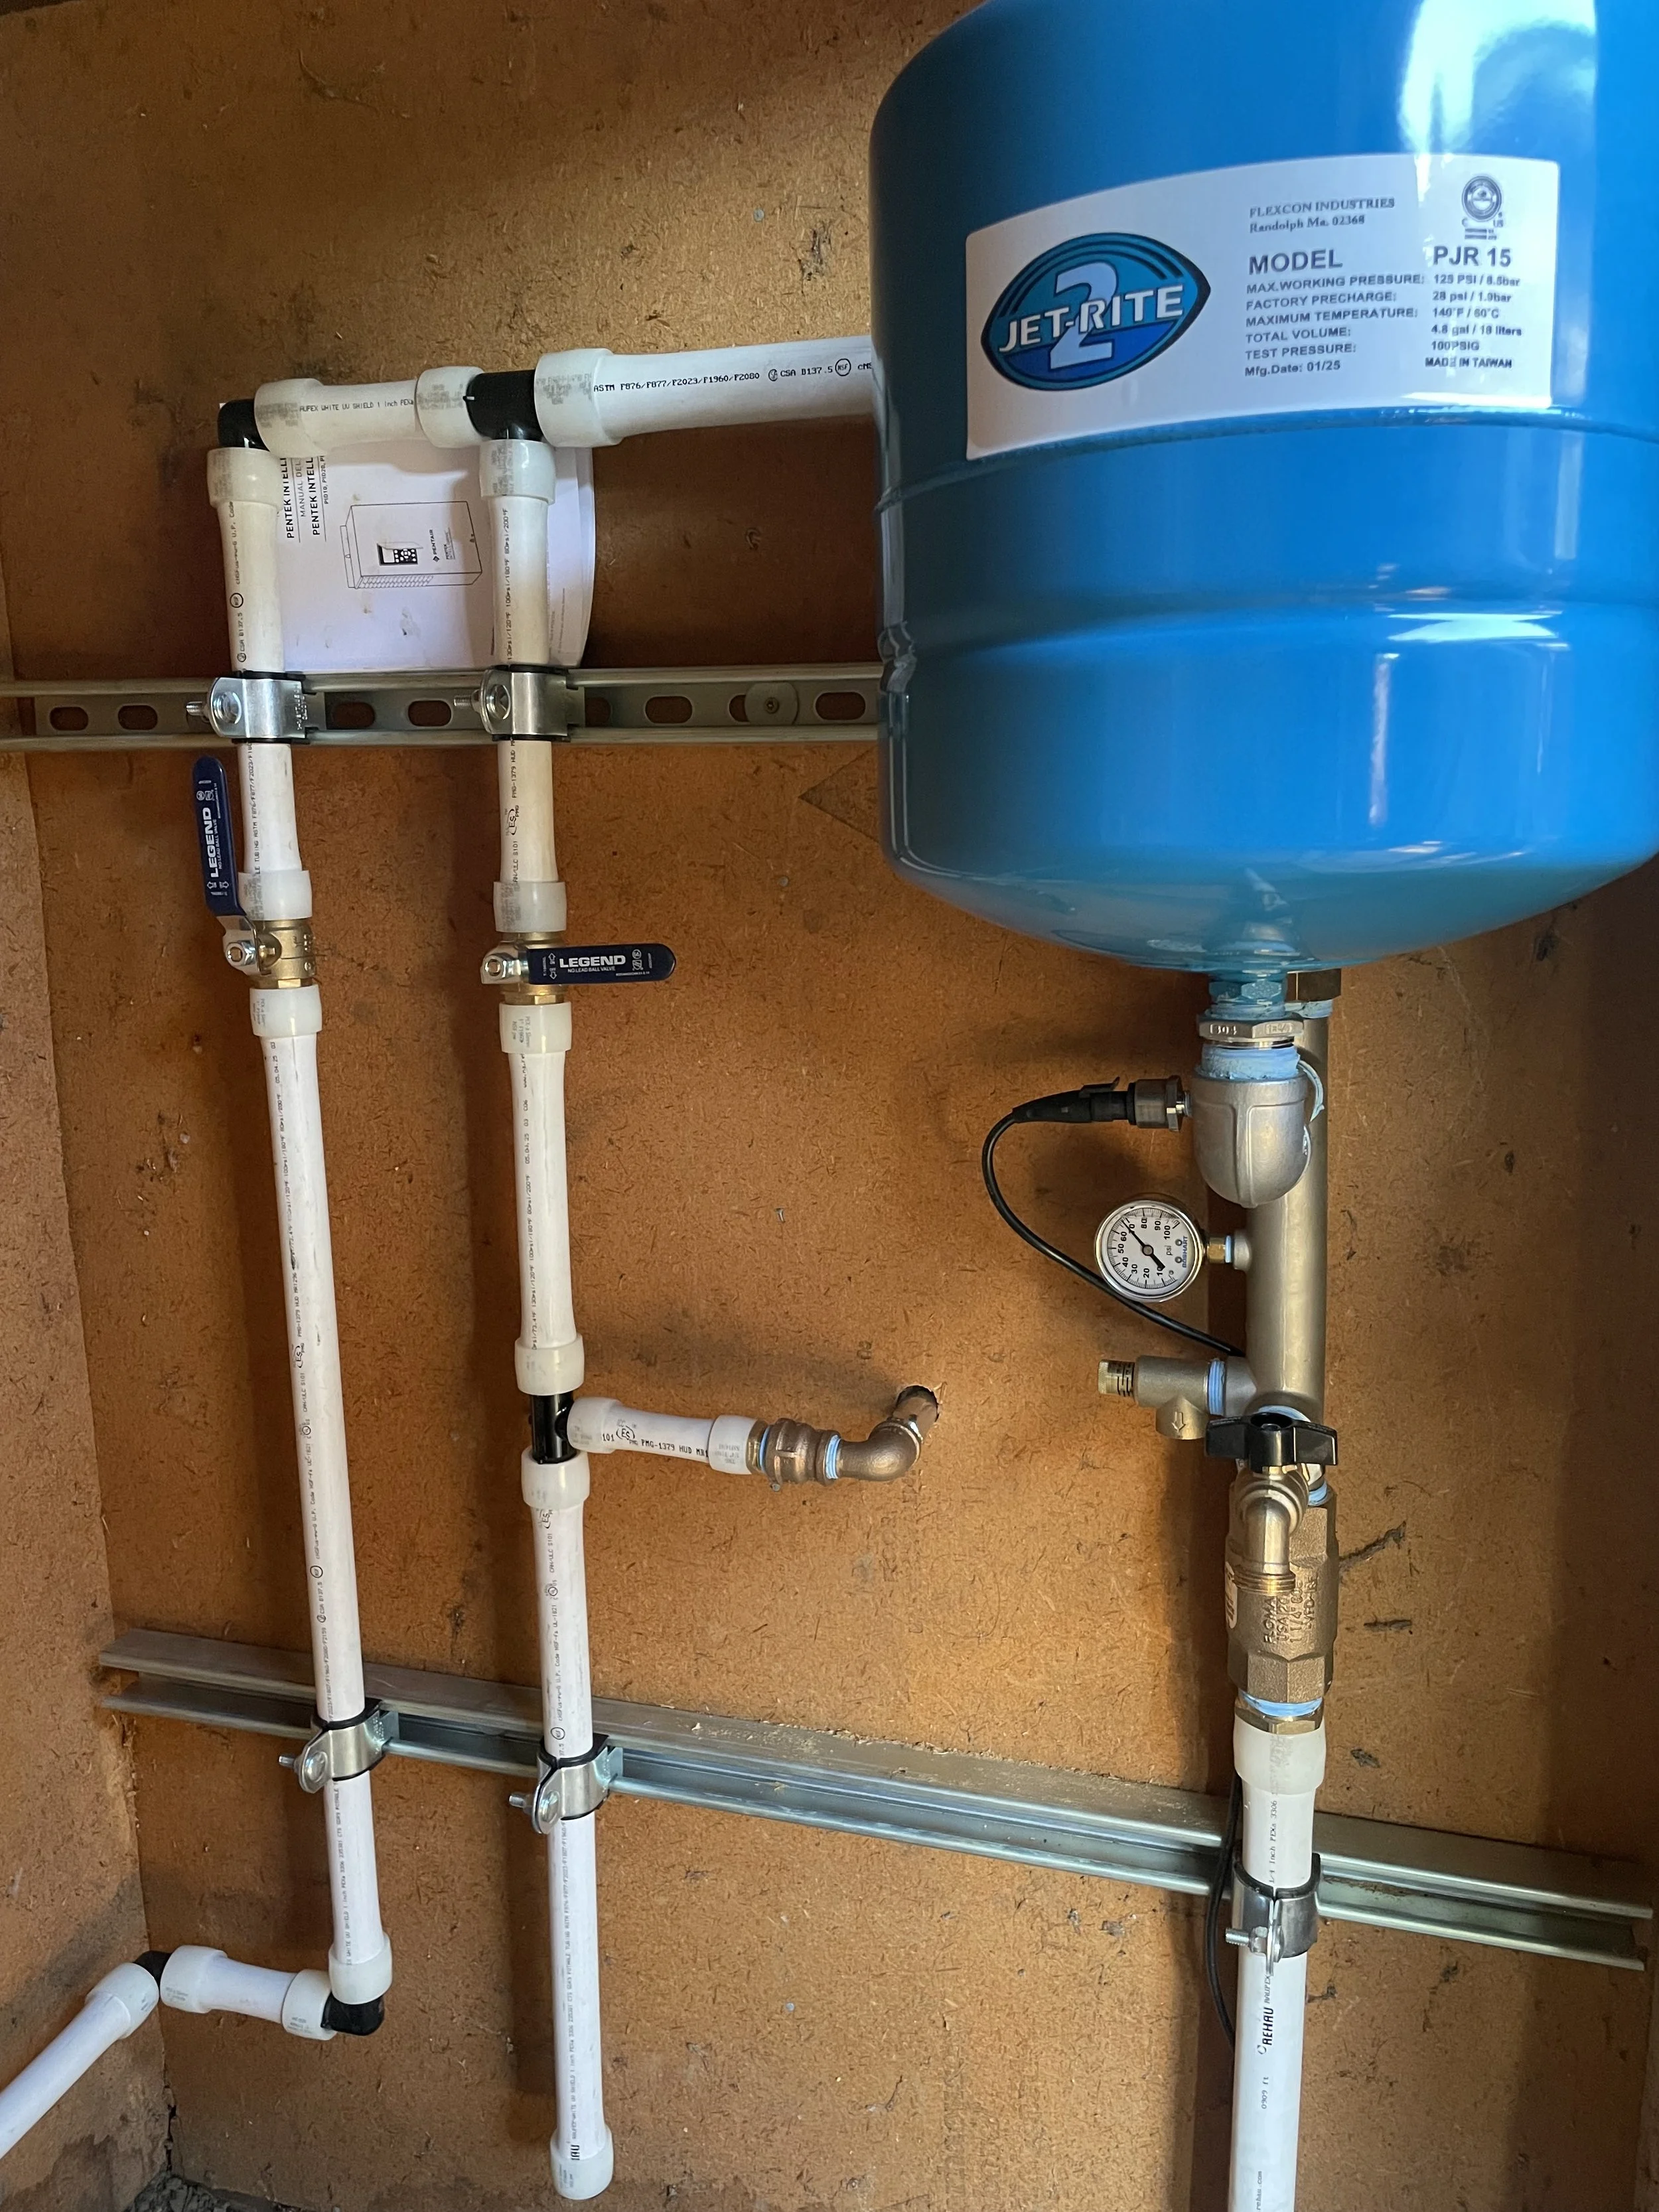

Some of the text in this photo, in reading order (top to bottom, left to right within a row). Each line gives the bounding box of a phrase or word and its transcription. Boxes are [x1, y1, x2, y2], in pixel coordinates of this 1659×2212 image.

[1250, 196, 1395, 218] FLEXCON INDUSTRIES
[1250, 217, 1303, 233] Randolph
[1249, 246, 1511, 275] MODEL PJR 15
[1246, 276, 1345, 294] MAX.WORKING
[1349, 273, 1425, 286] PRESSURE:
[1457, 274, 1477, 285] PSI
[1246, 295, 1308, 311] FACTORY
[1311, 291, 1396, 305] PRECHARGE:
[1433, 291, 1446, 301] 28
[1450, 291, 1467, 303] psi
[999, 284, 1184, 353] JET-RITE
[1049, 261, 1119, 370] 2
[1246, 312, 1311, 327] MAXIMUM
[1315, 307, 1418, 321] TEMPERATURE:
[1246, 332, 1287, 344] TOTAL
[1292, 327, 1352, 339] VOLUME:
[1496, 325, 1522, 336] liters
[1245, 340, 1480, 360] TEST PRESSURE: 100PSIG
[1244, 364, 1303, 378] Mfg.Date:
[1307, 360, 1340, 372] 01/25
[1459, 357, 1470, 368] IN
[1473, 356, 1512, 369] TAIWAN
[593, 383, 615, 392] ASTM
[780, 369, 796, 378] CSA
[297, 480, 306, 517] MANUAL
[283, 499, 295, 538] PENTEK
[309, 496, 320, 536] PENTEK
[202, 807, 219, 877] LEGEND
[559, 955, 626, 968] LEGEND
[1141, 1217, 1147, 1229] 80
[1155, 1220, 1161, 1230] 90
[1121, 1231, 1127, 1242] 60
[1118, 1243, 1124, 1254] 50
[1122, 1257, 1129, 1267] 40
[1131, 1264, 1137, 1274] 30
[1143, 1268, 1150, 1278] 20
[641, 1438, 675, 1451] PMG-1379
[679, 1444, 692, 1454] HUD
[1262, 2007, 1274, 2045] REHAU
[1262, 2076, 1269, 2085] ft
